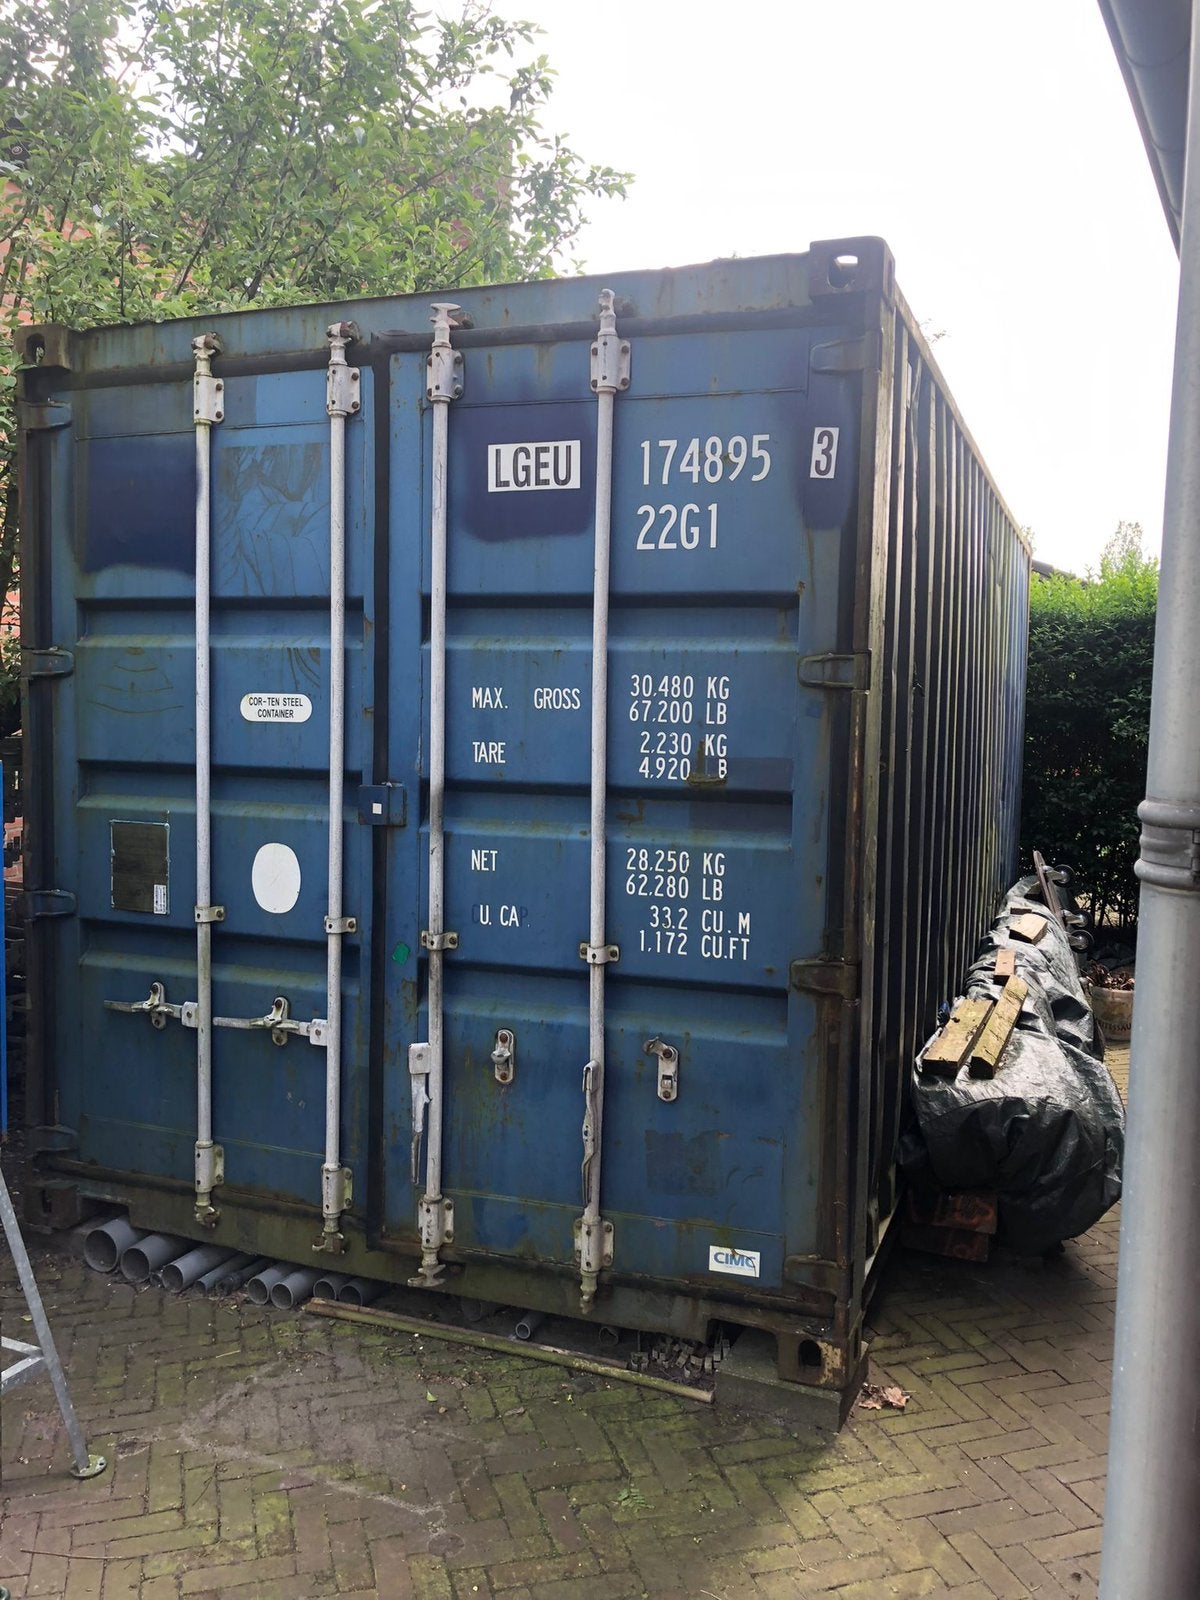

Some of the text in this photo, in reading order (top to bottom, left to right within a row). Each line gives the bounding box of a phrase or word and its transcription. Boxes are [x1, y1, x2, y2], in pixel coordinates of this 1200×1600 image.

[494, 430, 834, 488] LGEU 174895 3
[636, 503, 719, 550] 22G1
[472, 687, 581, 709] MAX. GROSS
[630, 674, 730, 700] 30,480 KG
[248, 696, 303, 707] COR-TEN STEEL
[257, 708, 294, 719] CONTAINER
[629, 700, 727, 725] 67,200 LB
[472, 742, 506, 764] TARE
[640, 731, 728, 757] 2,230 KG
[639, 757, 691, 780] 4,920
[471, 850, 498, 871] NET
[626, 848, 726, 877] 28,250 KG
[626, 874, 723, 901] 62,280 LB
[650, 906, 688, 930] 33.2
[639, 930, 688, 955] 1,172
[713, 1252, 756, 1269] CIMC
